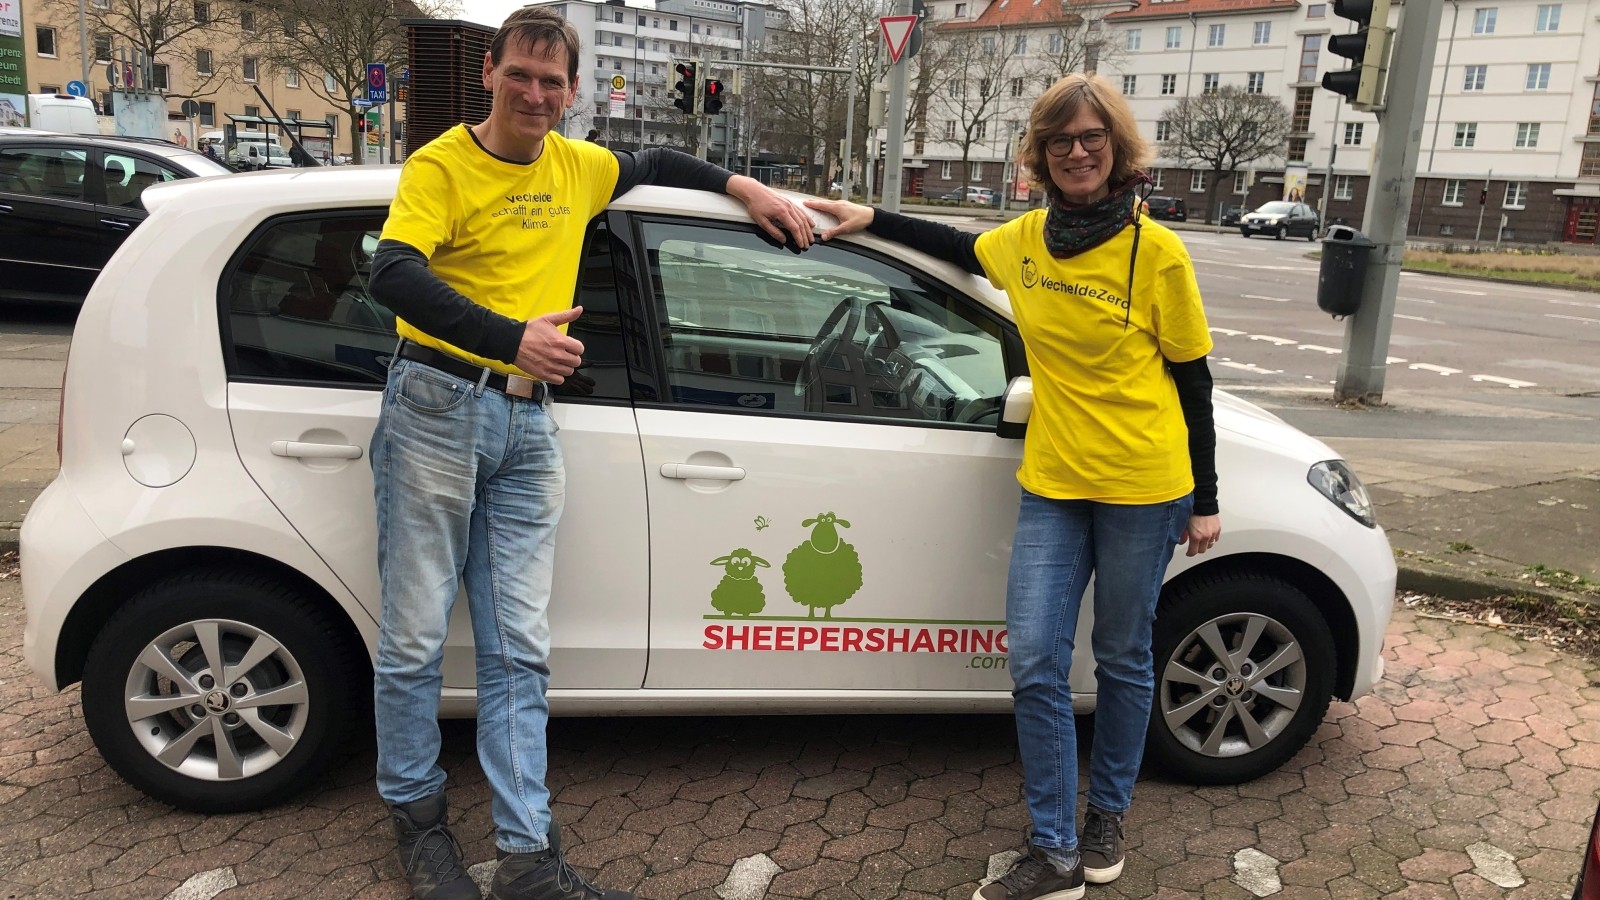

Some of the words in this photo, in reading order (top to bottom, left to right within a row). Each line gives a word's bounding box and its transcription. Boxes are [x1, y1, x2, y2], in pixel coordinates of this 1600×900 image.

[370, 90, 385, 99] TAXI
[531, 207, 543, 216] ein
[548, 205, 571, 217] gutes
[1041, 275, 1130, 309] VecheldeZero
